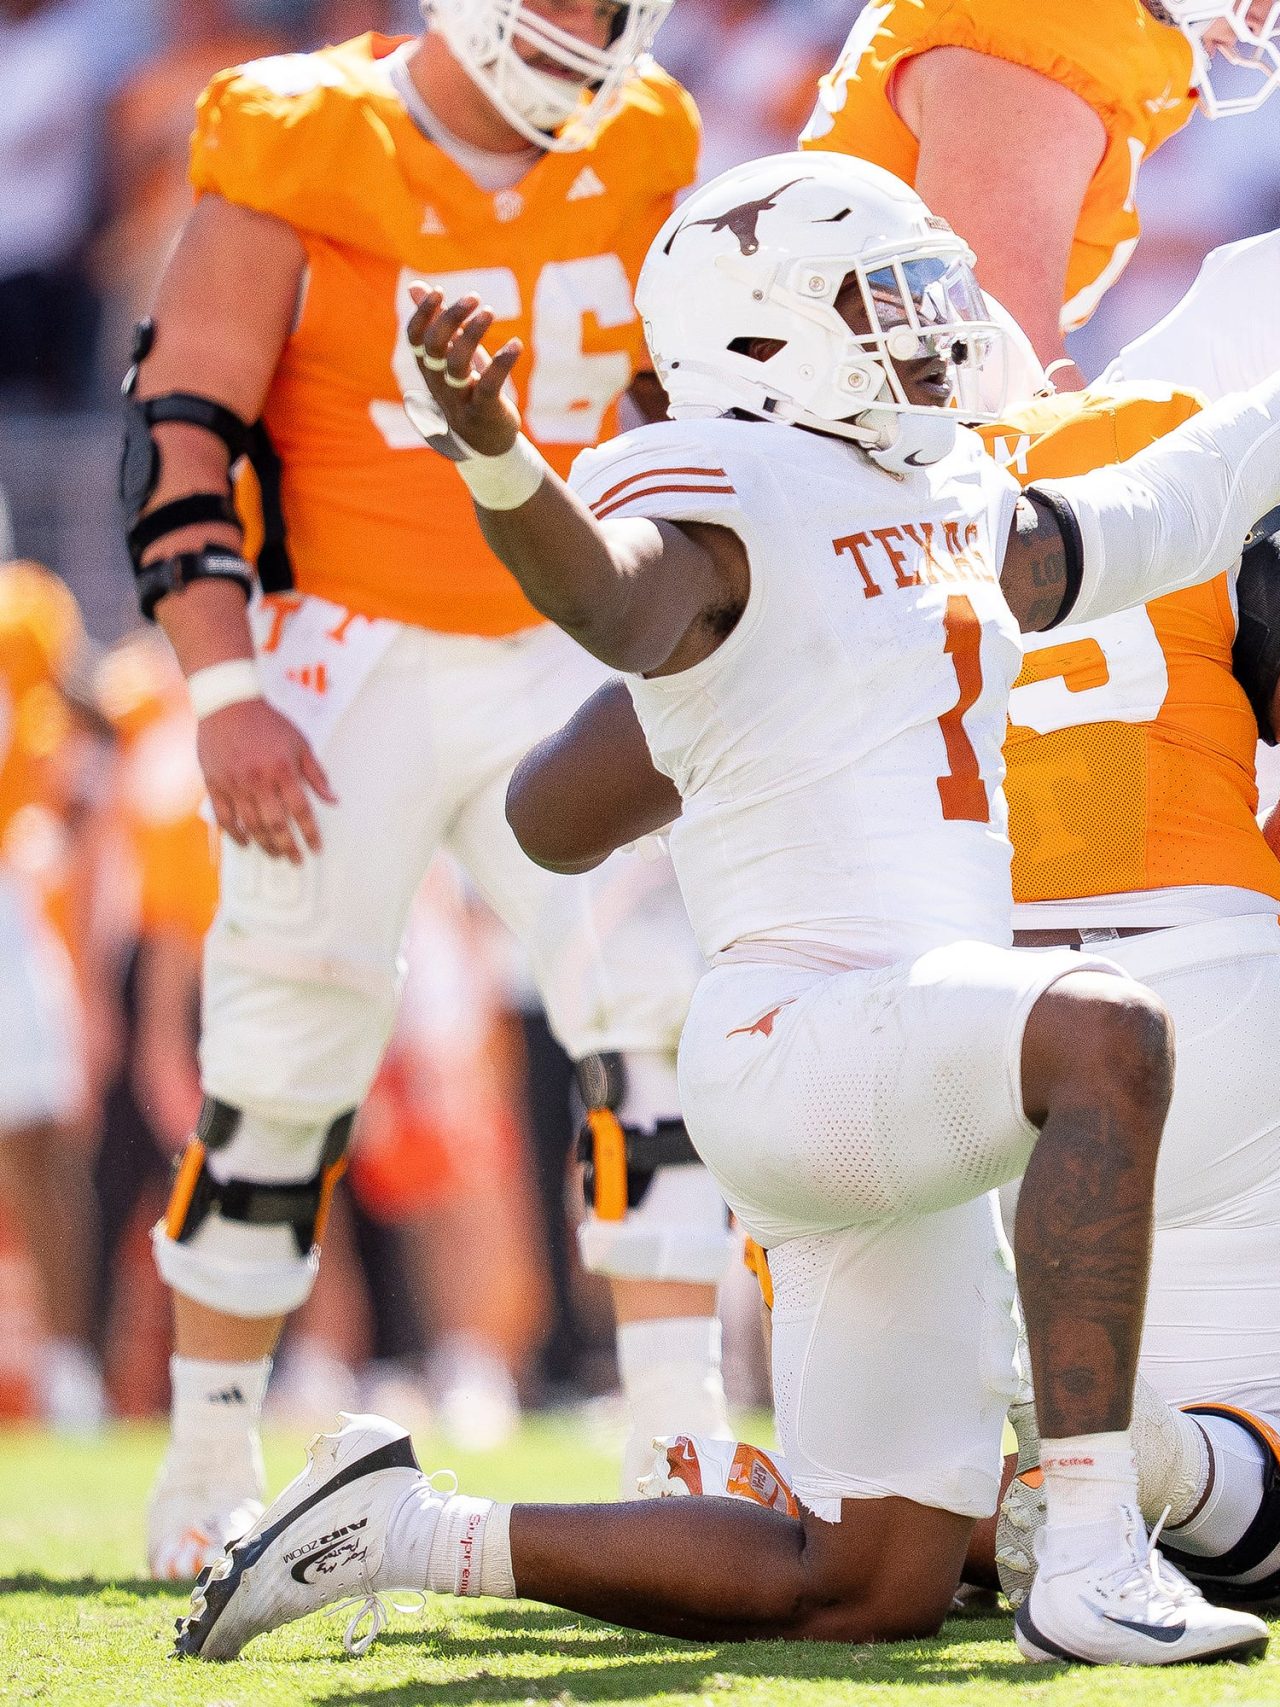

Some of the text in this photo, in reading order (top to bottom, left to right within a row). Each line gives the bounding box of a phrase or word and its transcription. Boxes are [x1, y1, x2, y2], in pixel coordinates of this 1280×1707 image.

[369, 253, 638, 449] 56
[832, 520, 995, 600] TEXAS
[936, 593, 991, 824] 1
[282, 1517, 368, 1564] AIR ZOOM
